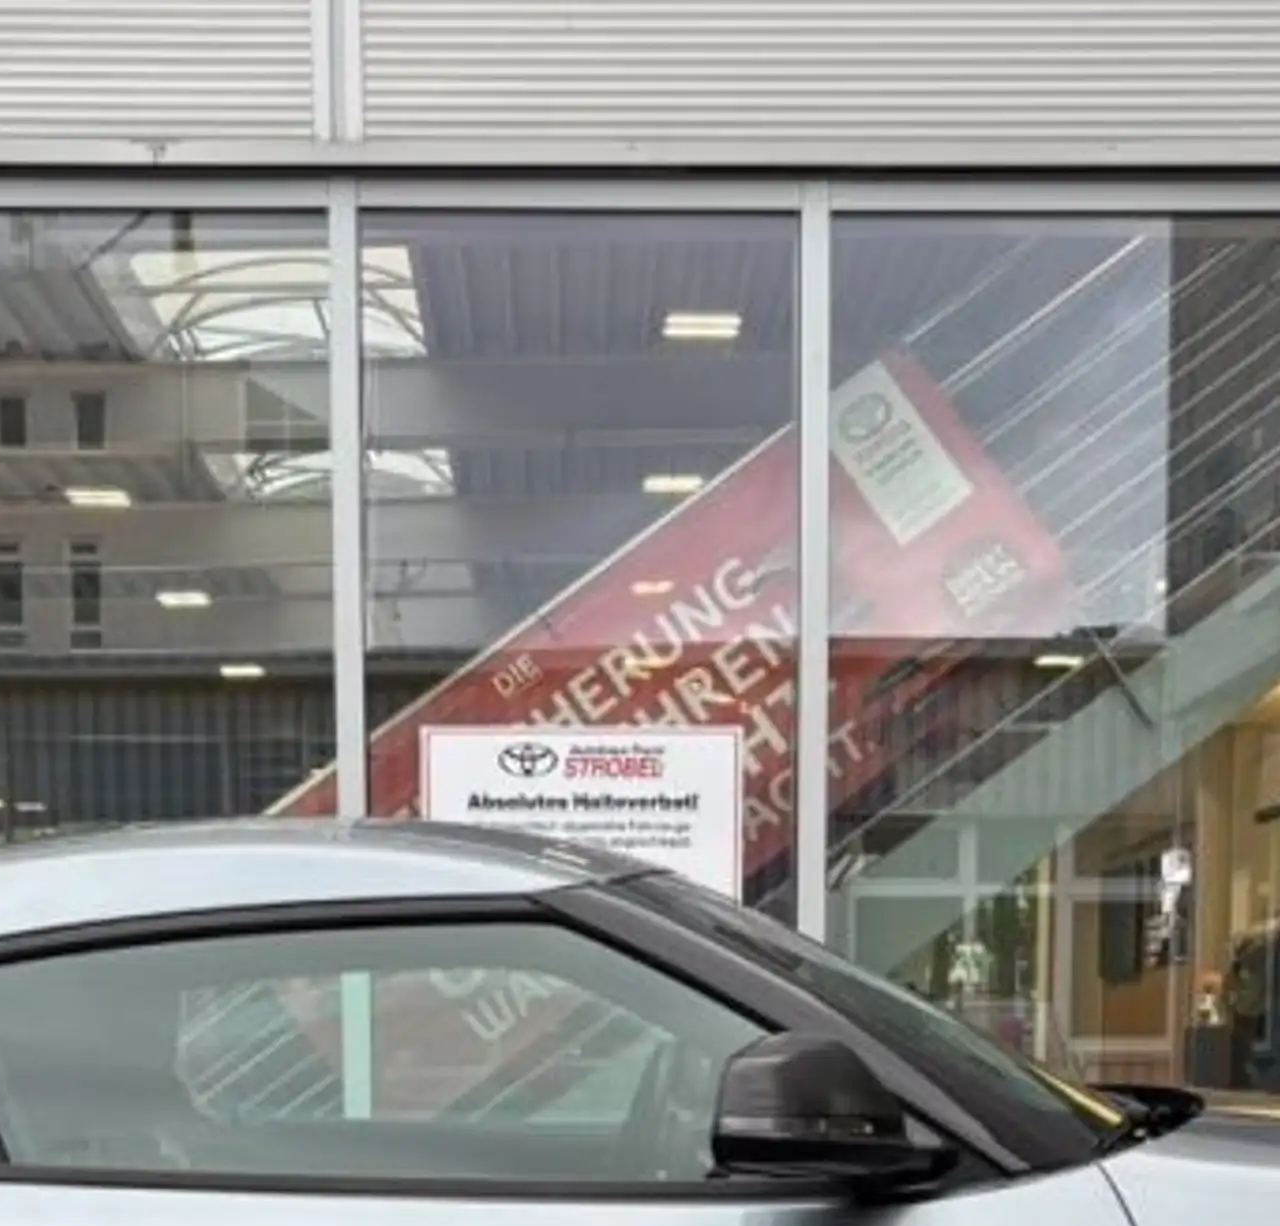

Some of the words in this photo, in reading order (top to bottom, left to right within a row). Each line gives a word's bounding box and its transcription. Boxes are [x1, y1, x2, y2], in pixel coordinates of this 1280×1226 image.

[511, 558, 757, 728] HERUNG
[491, 652, 544, 699] DIE
[563, 757, 664, 778] STROBEL
[467, 791, 568, 811] Absolutes
[572, 791, 700, 811] Halteverbot!
